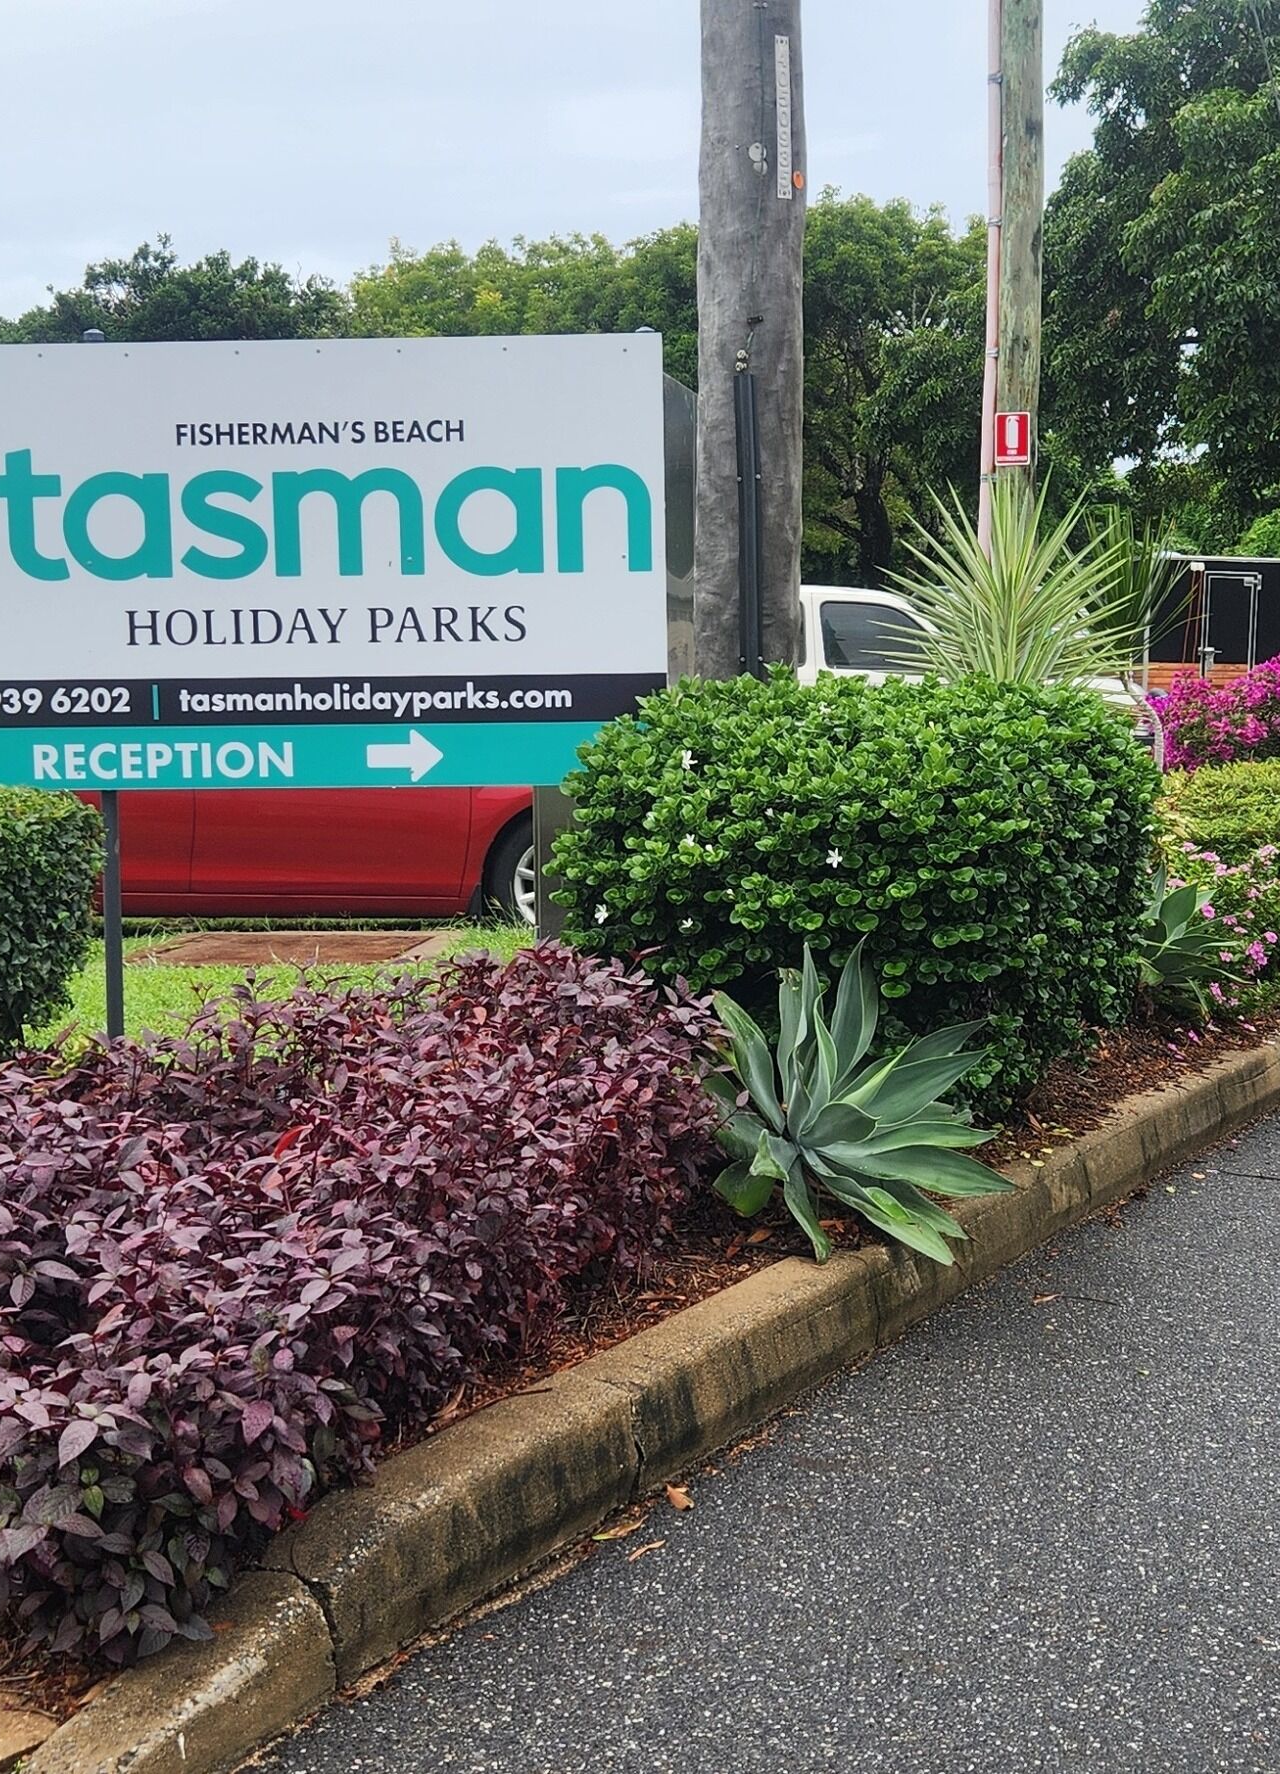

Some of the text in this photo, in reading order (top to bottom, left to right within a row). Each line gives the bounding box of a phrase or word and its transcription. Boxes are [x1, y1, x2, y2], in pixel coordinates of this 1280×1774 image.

[175, 419, 465, 446] FISHERMAN’S BEACH
[125, 605, 527, 646] HOLIDAY PARKS
[50, 686, 131, 714] 6202
[179, 682, 572, 718] tasmanholidayparks.com
[33, 742, 294, 780] RECEPTION
